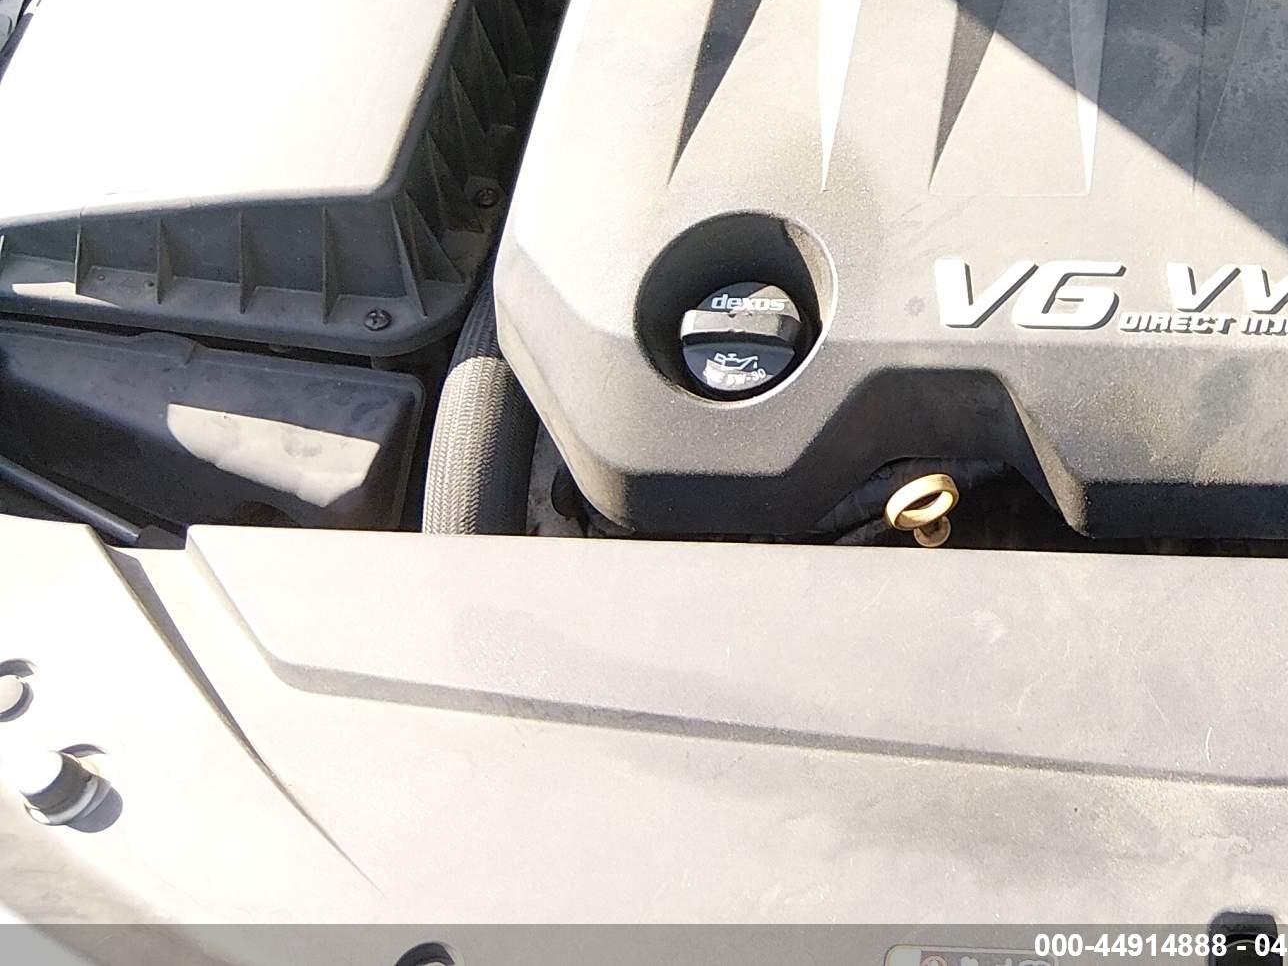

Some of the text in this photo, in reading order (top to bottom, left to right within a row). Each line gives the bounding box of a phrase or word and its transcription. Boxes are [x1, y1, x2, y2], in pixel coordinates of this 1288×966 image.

[710, 293, 788, 312] dexos
[934, 257, 1126, 329] V6
[1119, 312, 1237, 335] DIRECT
